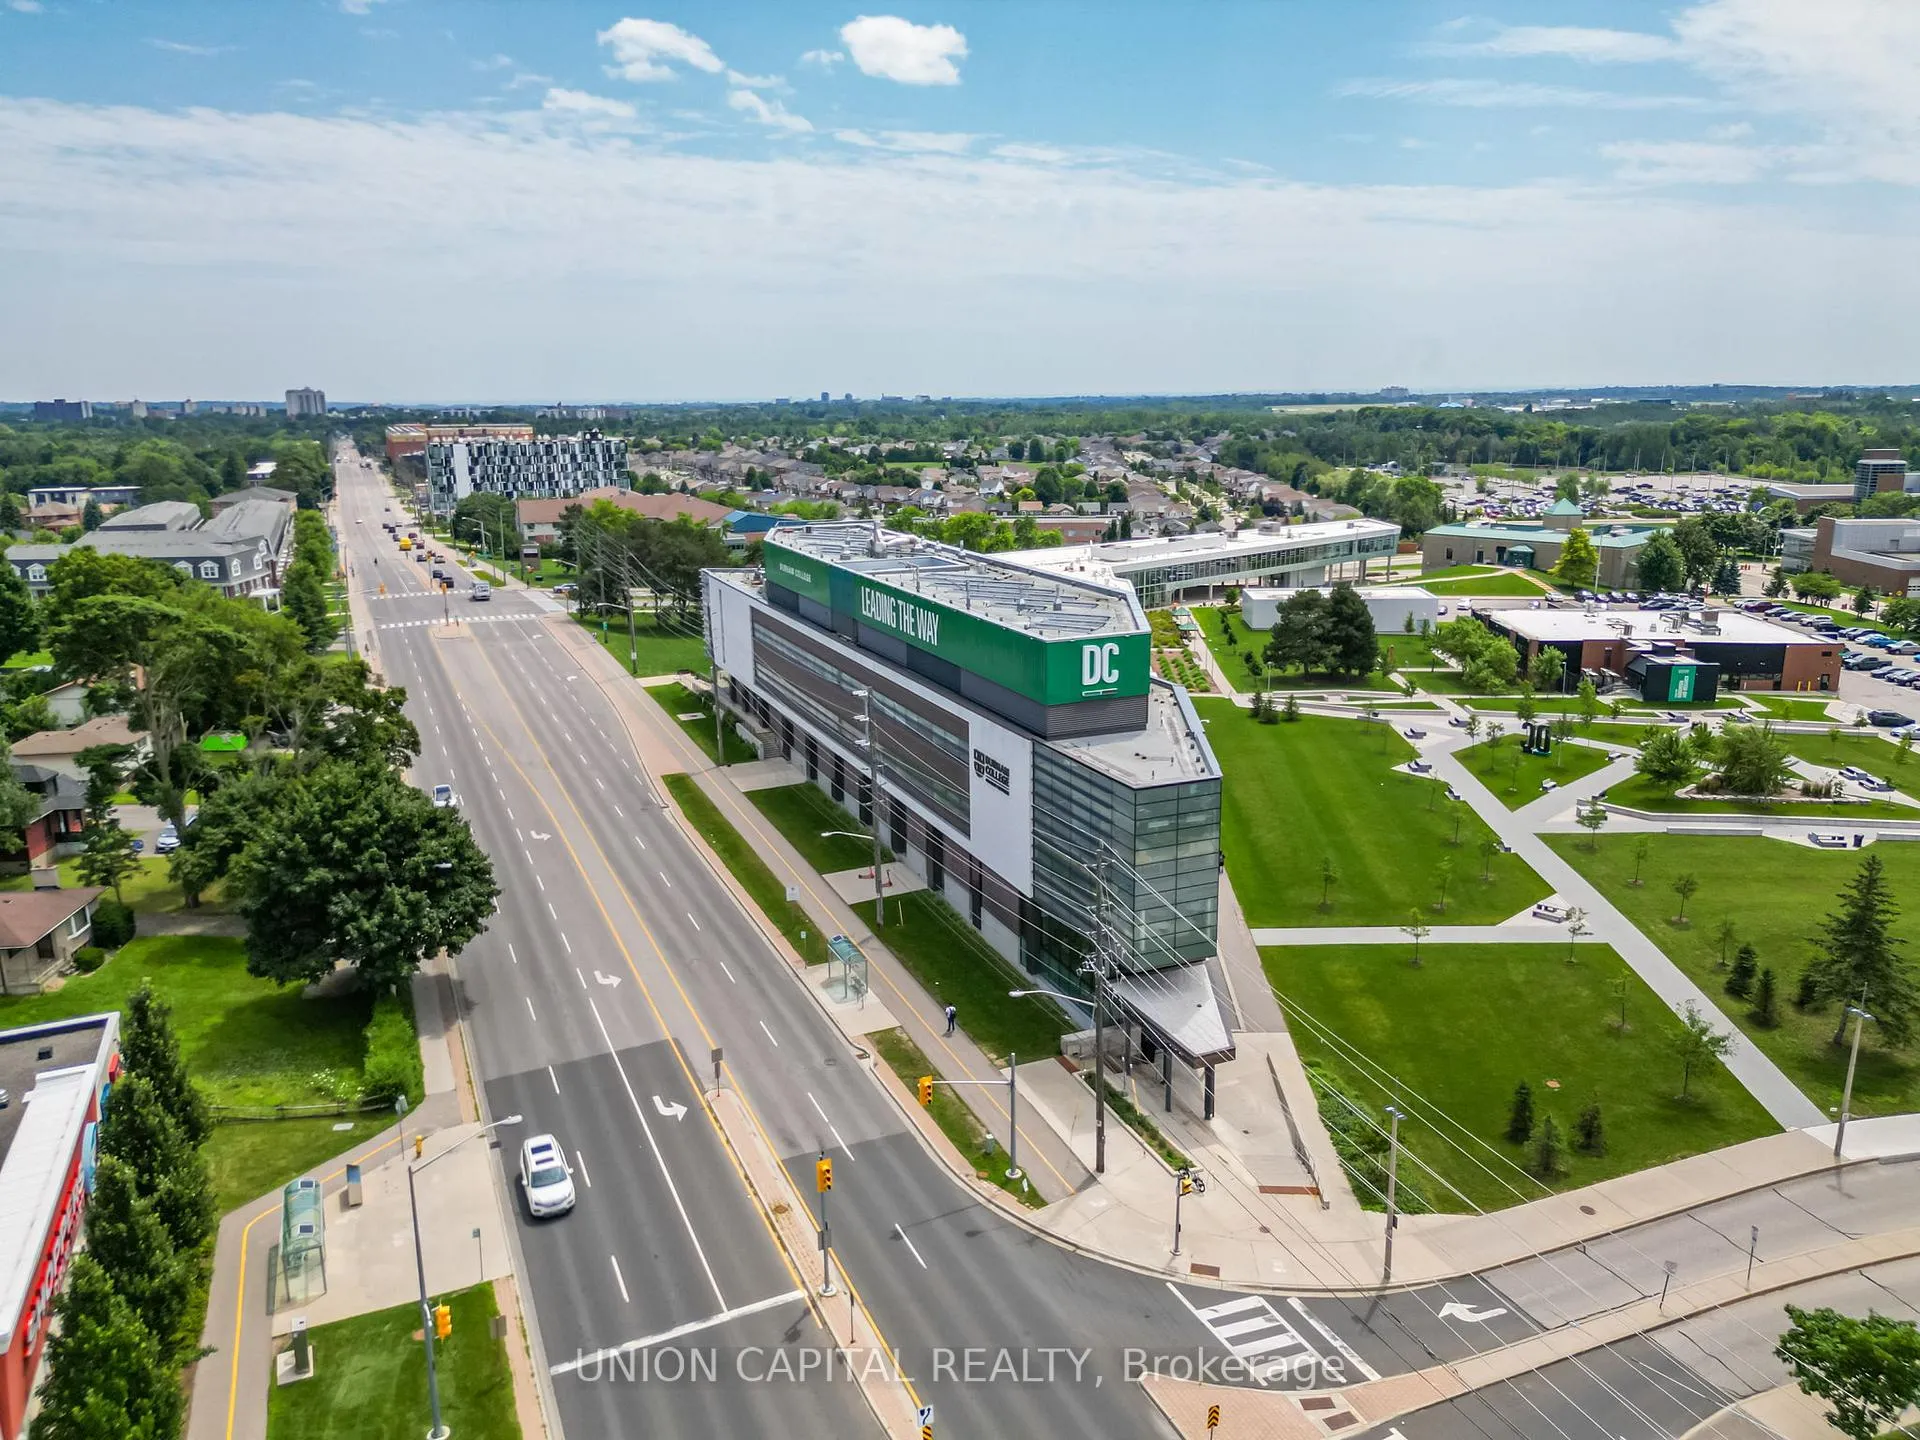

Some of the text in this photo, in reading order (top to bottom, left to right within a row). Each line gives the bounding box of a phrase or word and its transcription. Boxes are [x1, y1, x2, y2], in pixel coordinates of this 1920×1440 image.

[861, 586, 939, 646] LEADING THE WAY
[1082, 643, 1120, 686] DC
